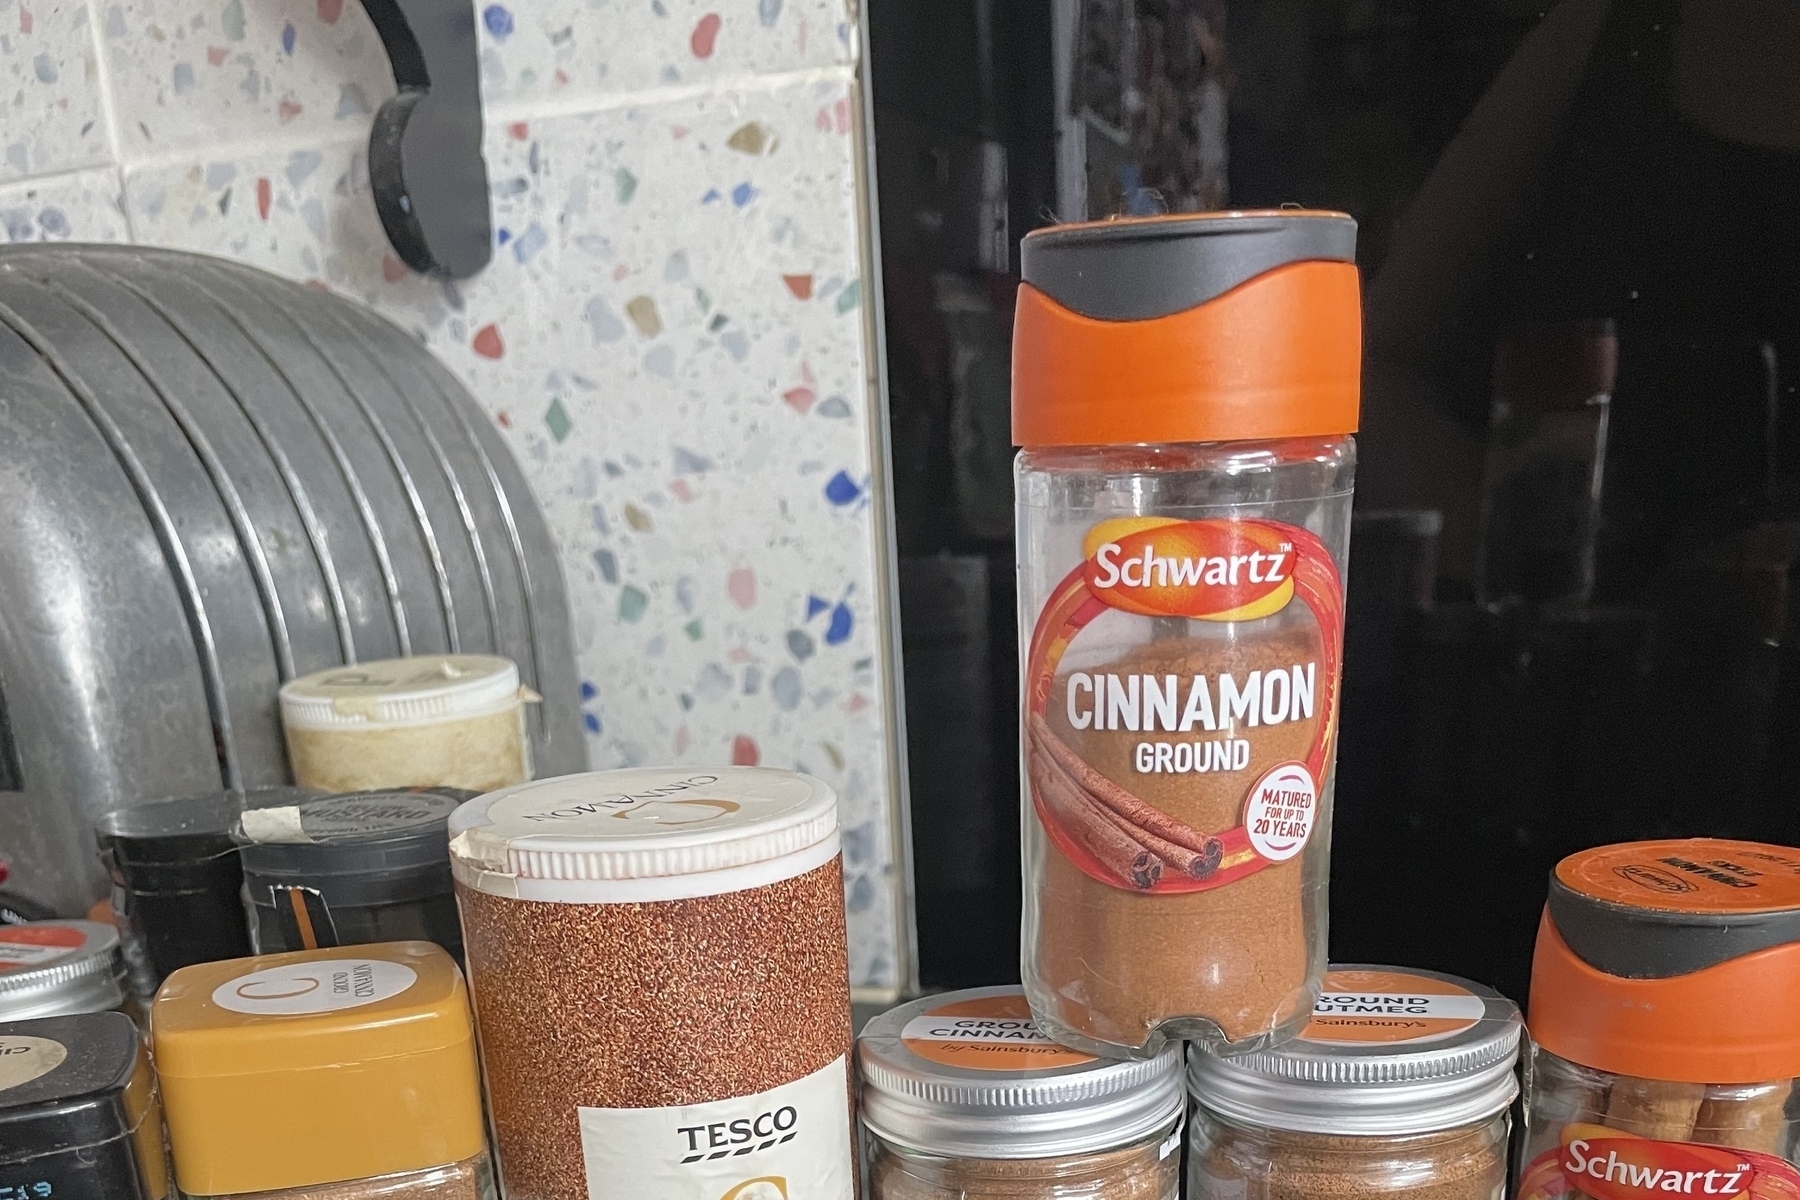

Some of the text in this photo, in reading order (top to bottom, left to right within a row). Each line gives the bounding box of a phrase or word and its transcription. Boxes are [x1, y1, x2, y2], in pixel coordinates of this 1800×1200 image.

[1094, 543, 1285, 588] Schwartz
[1066, 662, 1316, 732] CINNAMON
[1135, 738, 1250, 773] GROUND
[522, 775, 718, 822] CINNAMON
[1261, 788, 1312, 808] MATURED
[1265, 806, 1305, 821] FOR UP TO
[1253, 819, 1307, 838] 20 YEARS
[236, 976, 320, 1001] C
[1314, 1004, 1428, 1014] UTMEG
[1319, 996, 1430, 1005] ROUND
[929, 1028, 1052, 1040] CINNAM
[954, 1020, 1038, 1030] GROU
[1316, 1019, 1428, 1029] Sainsbury's
[677, 1105, 798, 1152] TESCO
[1565, 1139, 1742, 1195] Schwartz
